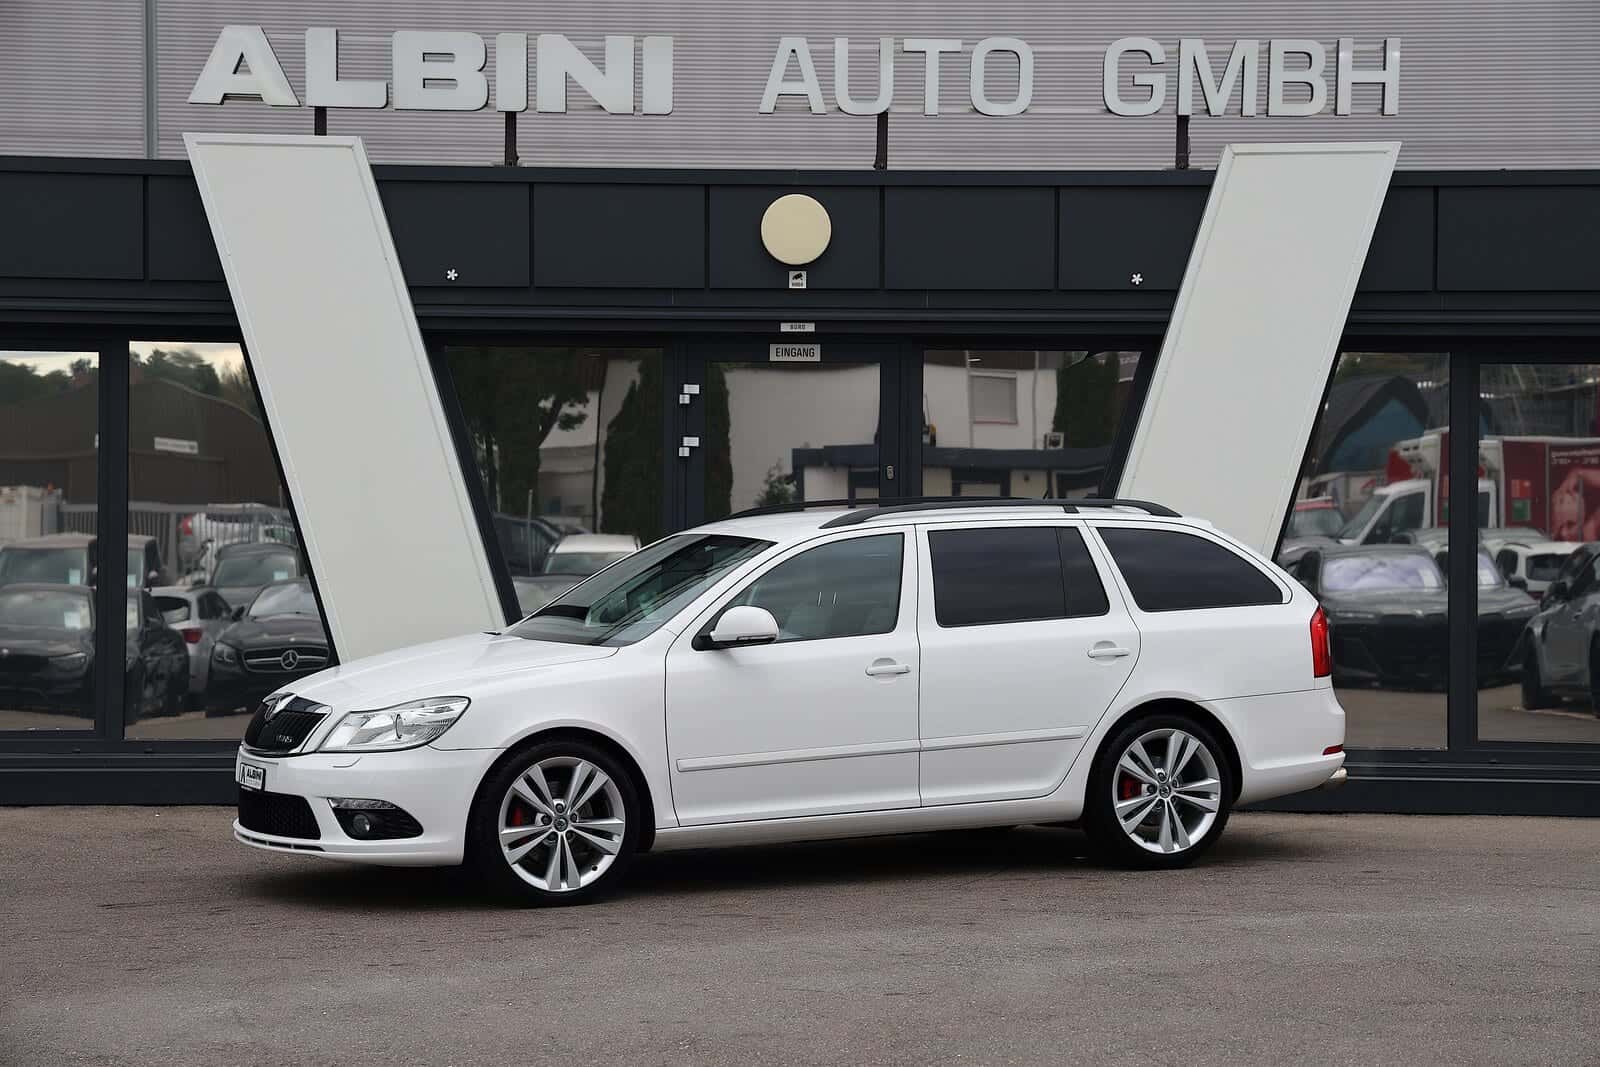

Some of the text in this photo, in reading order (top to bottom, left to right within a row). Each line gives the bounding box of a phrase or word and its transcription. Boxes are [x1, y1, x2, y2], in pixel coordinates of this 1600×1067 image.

[187, 24, 1401, 117] ALBINI AUTO GMBH
[775, 347, 815, 358] EINGANG
